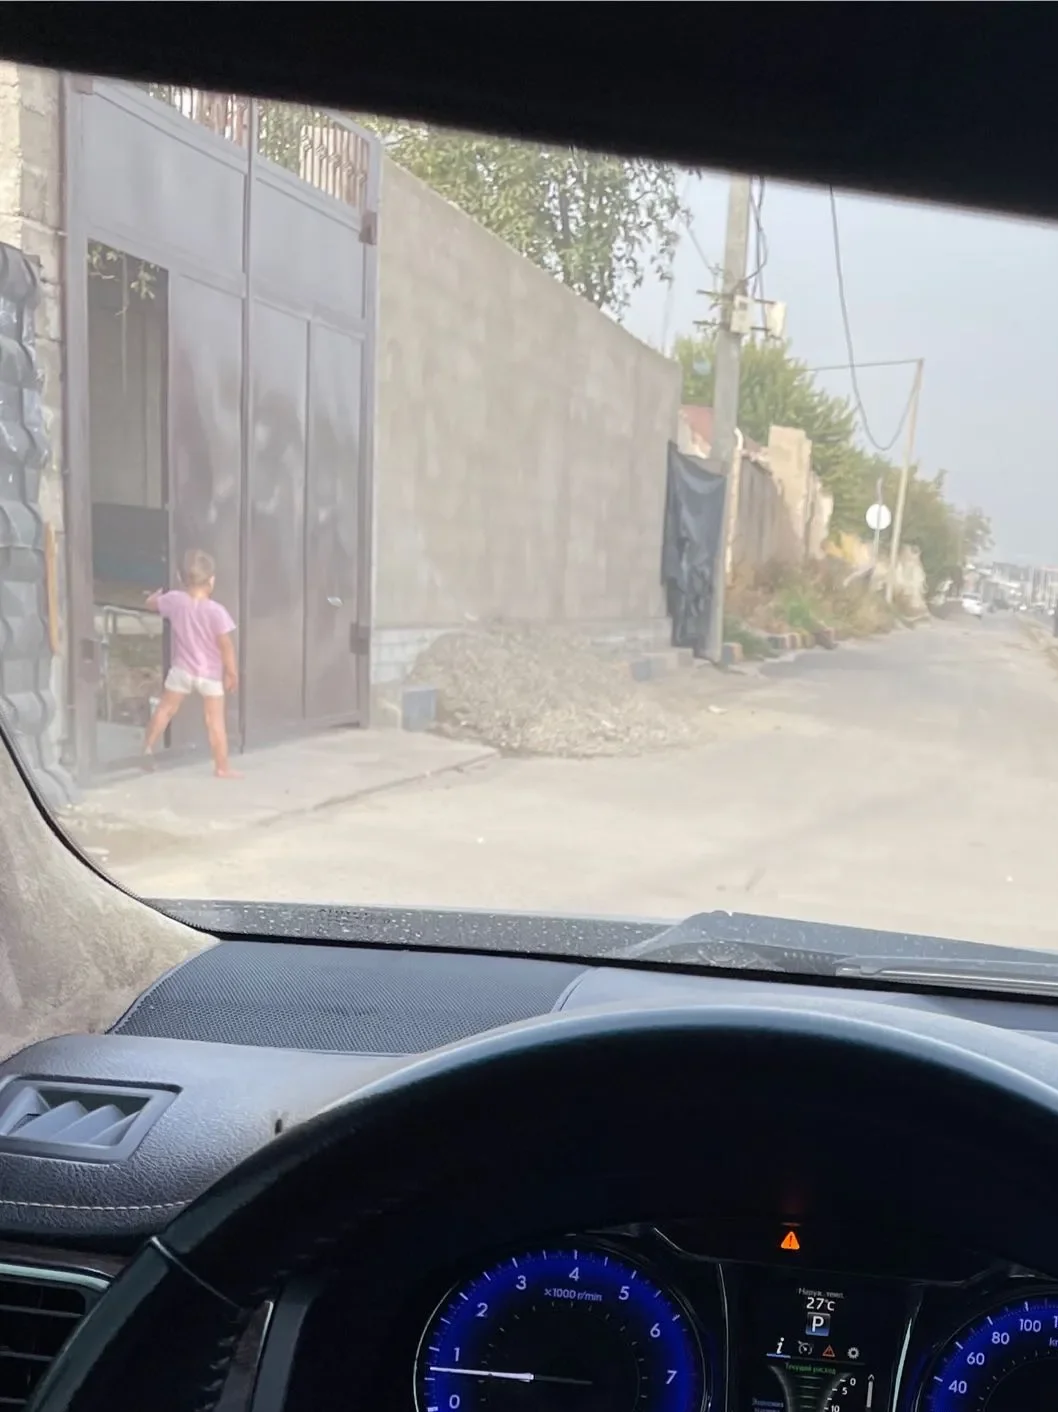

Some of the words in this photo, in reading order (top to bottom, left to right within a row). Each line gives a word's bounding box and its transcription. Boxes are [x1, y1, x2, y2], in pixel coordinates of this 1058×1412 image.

[515, 1274, 527, 1290] 3
[568, 1266, 580, 1282] 4
[618, 1286, 630, 1301] 5
[476, 1302, 488, 1318] 2
[650, 1322, 661, 1338] 6
[811, 1315, 825, 1333] P
[1019, 1317, 1042, 1333] 100
[991, 1331, 1010, 1346] 80
[453, 1347, 461, 1362] 1
[966, 1352, 986, 1366] 60
[665, 1369, 678, 1385] 7
[849, 1377, 857, 1387] 0
[841, 1387, 848, 1397] 5
[948, 1380, 968, 1394] 40
[448, 1394, 461, 1410] 0
